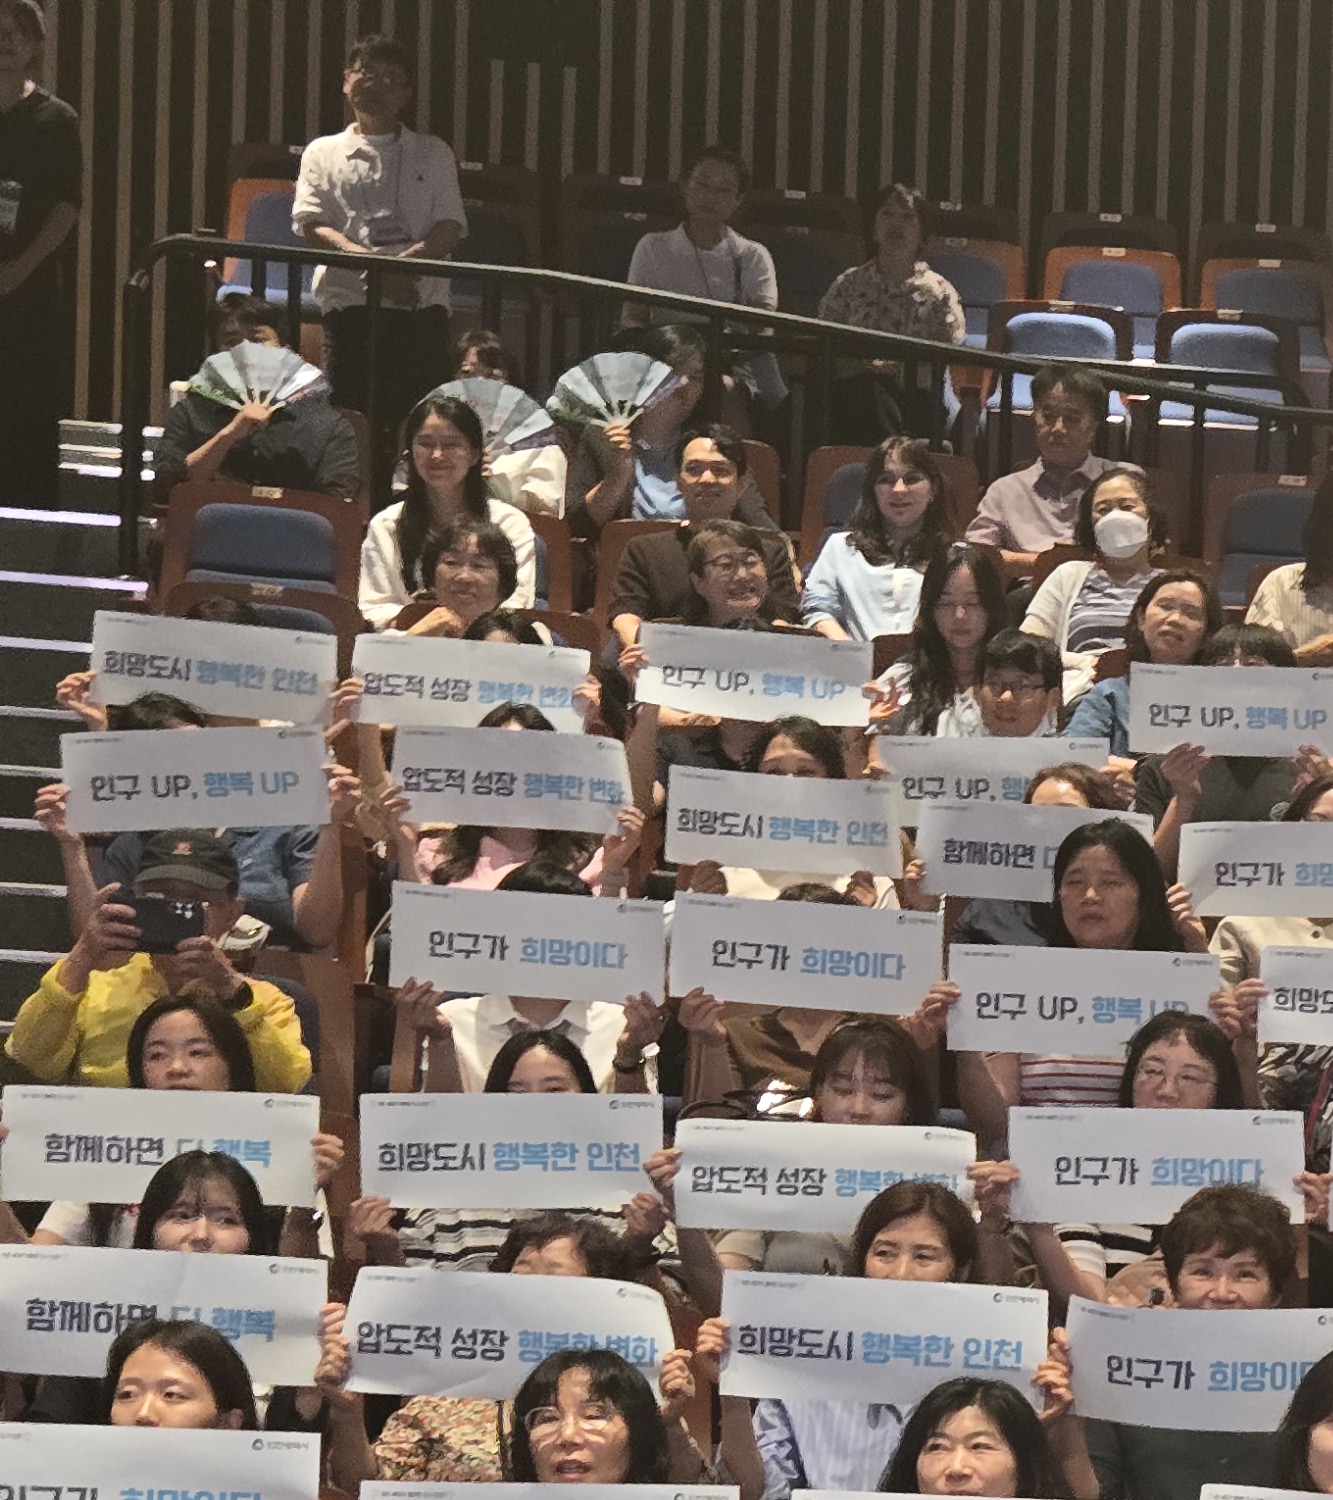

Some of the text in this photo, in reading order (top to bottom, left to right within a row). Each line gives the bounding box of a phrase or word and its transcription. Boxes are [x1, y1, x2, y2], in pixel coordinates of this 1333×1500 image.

[661, 664, 846, 700] 인구 UP, 행복 UP
[1148, 702, 1327, 730] 인구 UP, 행복 UP
[711, 939, 906, 980] 인구가 희망이다
[377, 1141, 644, 1173] 희망도시 행복한 인천
